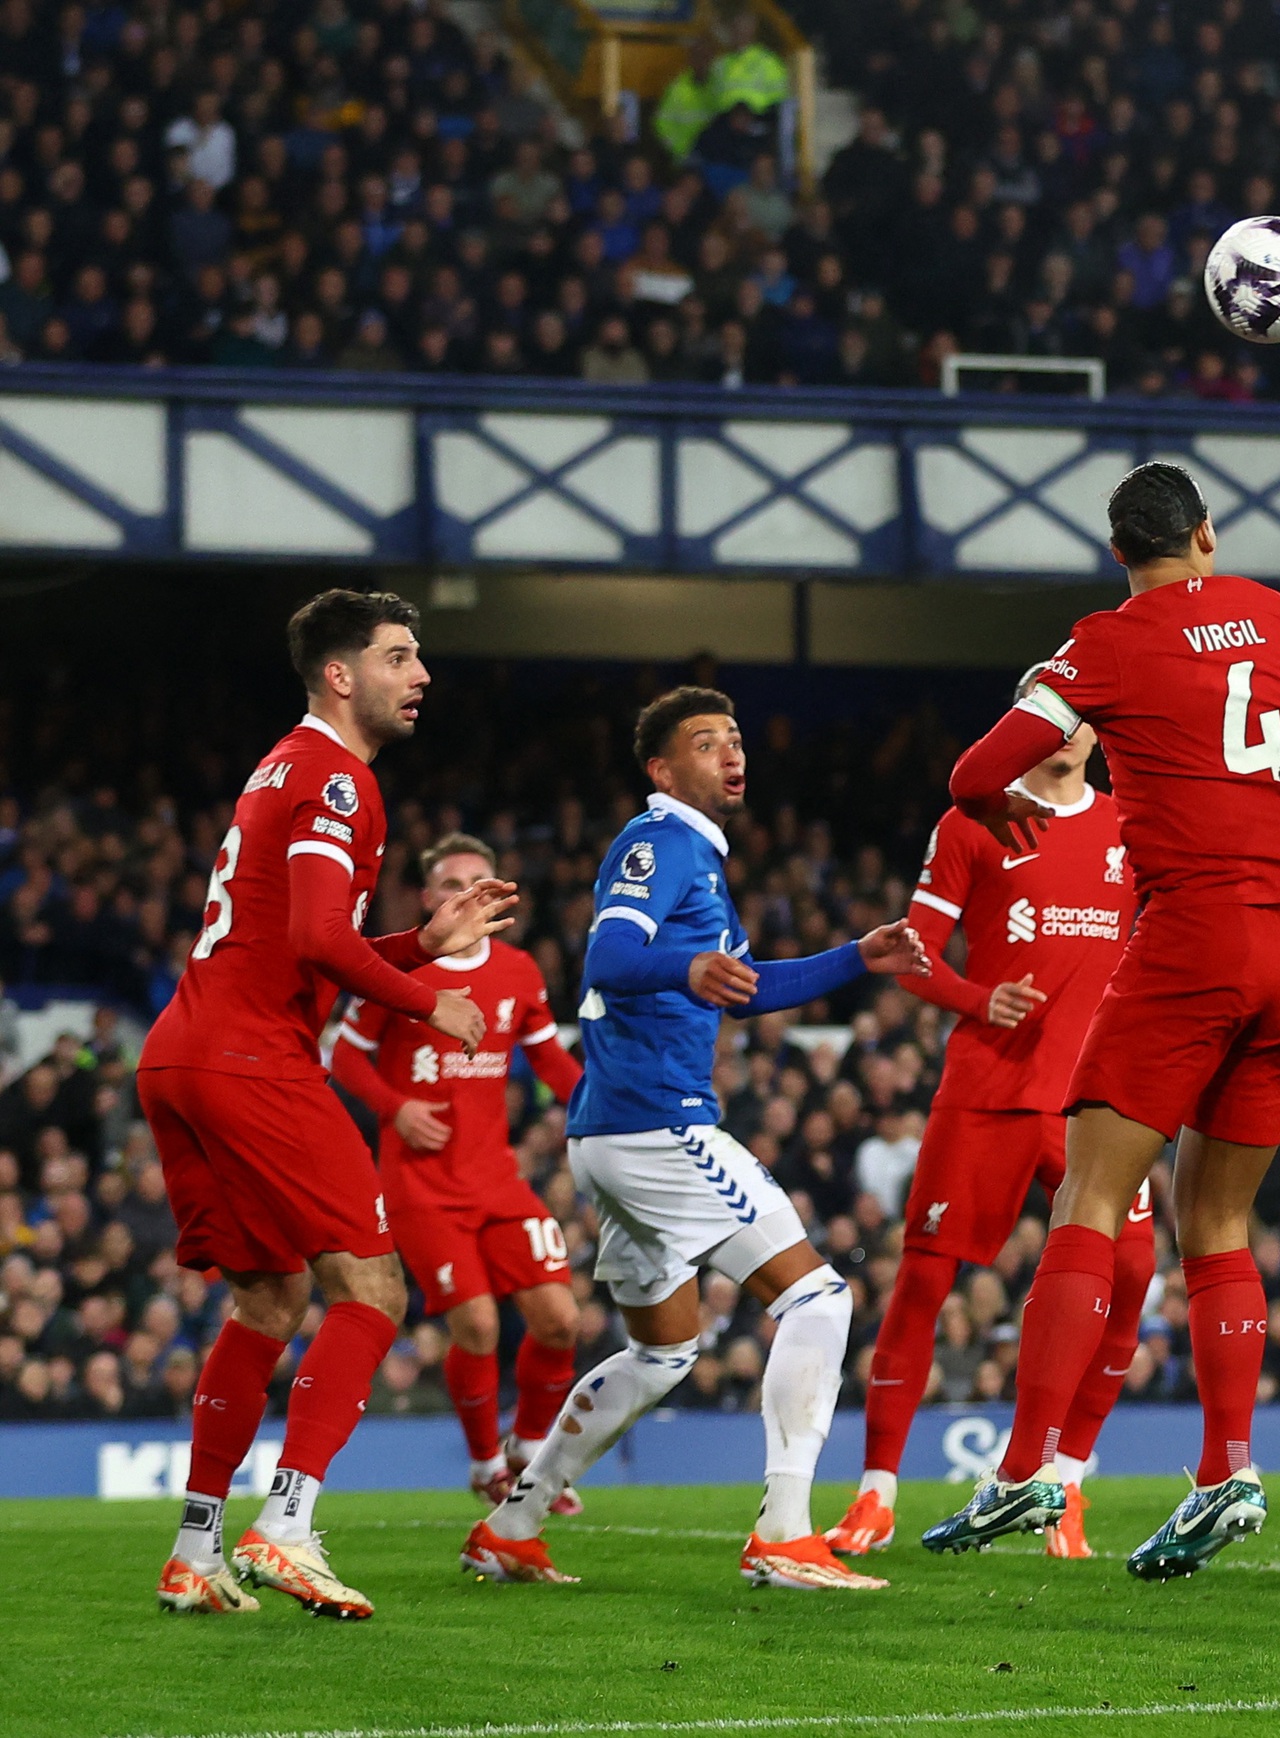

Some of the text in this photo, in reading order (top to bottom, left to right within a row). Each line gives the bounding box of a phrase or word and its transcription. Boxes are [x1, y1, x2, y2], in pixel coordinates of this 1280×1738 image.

[1183, 618, 1266, 653] VIRGIL
[1042, 904, 1120, 925] standard
[1041, 920, 1120, 941] chartered
[522, 1216, 568, 1262] 10
